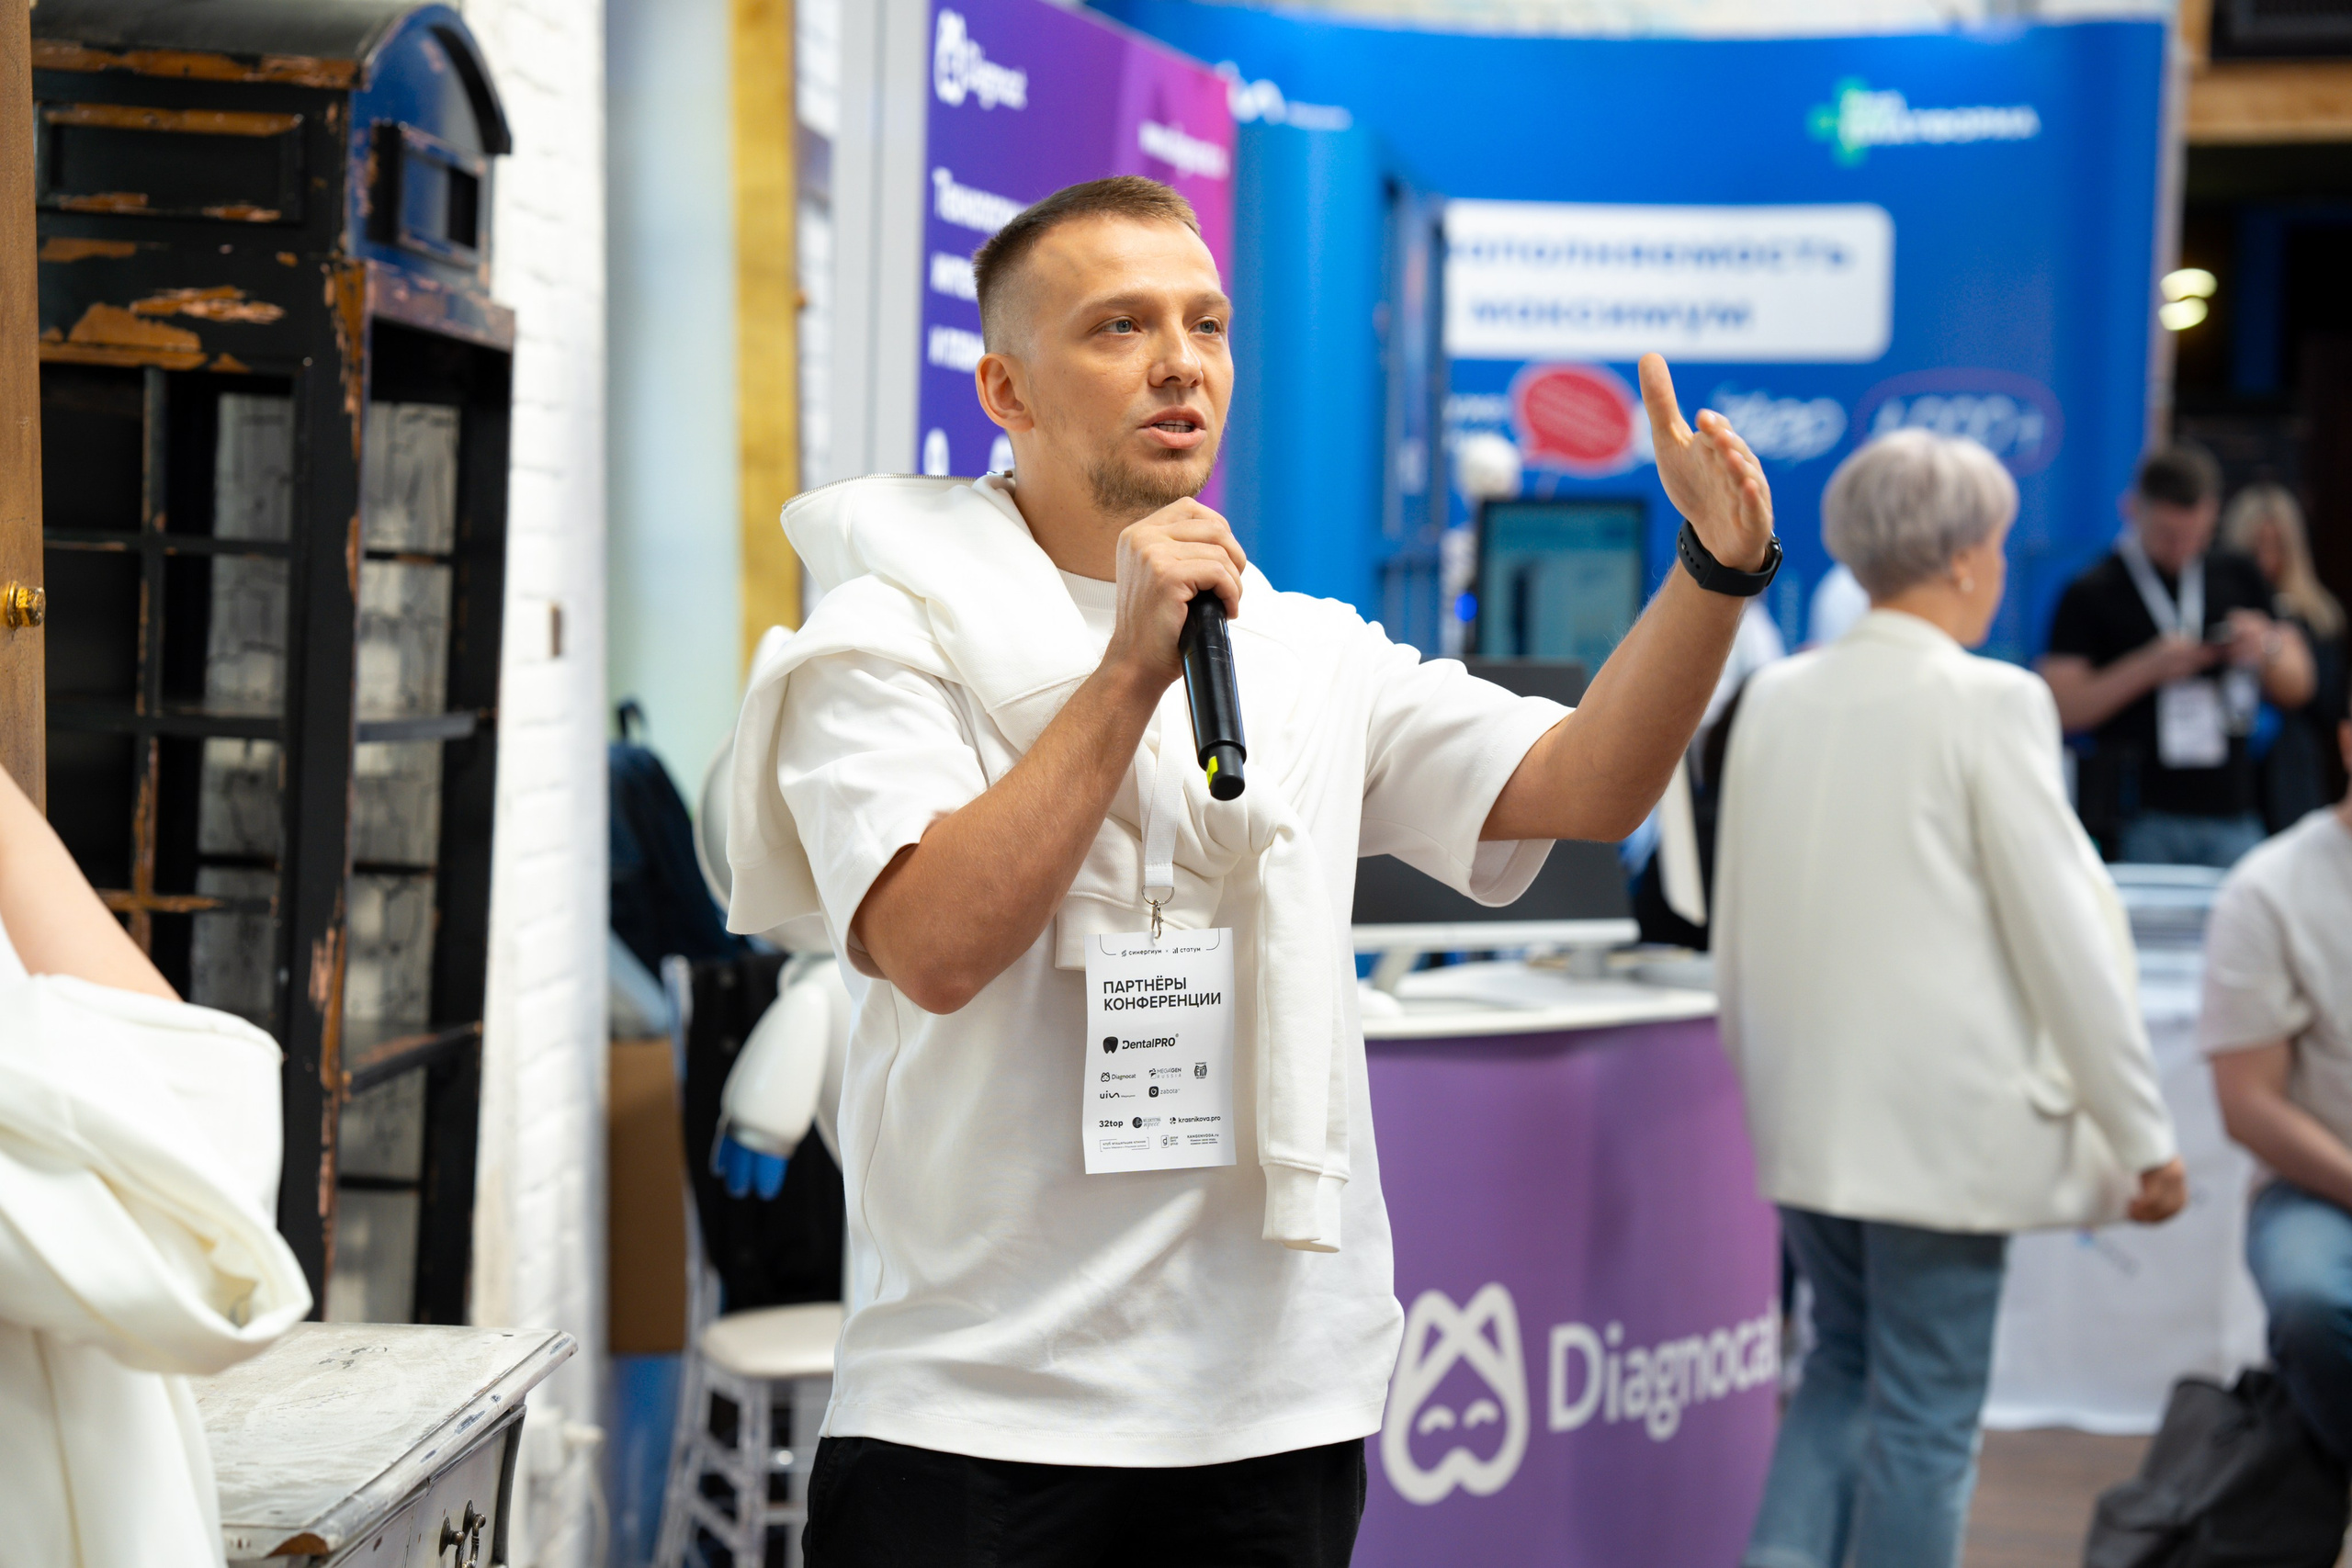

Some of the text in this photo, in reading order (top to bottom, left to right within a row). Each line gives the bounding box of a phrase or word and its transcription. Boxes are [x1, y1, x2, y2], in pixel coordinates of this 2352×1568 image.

[1103, 976, 1187, 994] ПАРТНЁРЫ
[1104, 992, 1221, 1010] КОНФЕРЕНЦИИ
[1099, 1120, 1123, 1128] 32top
